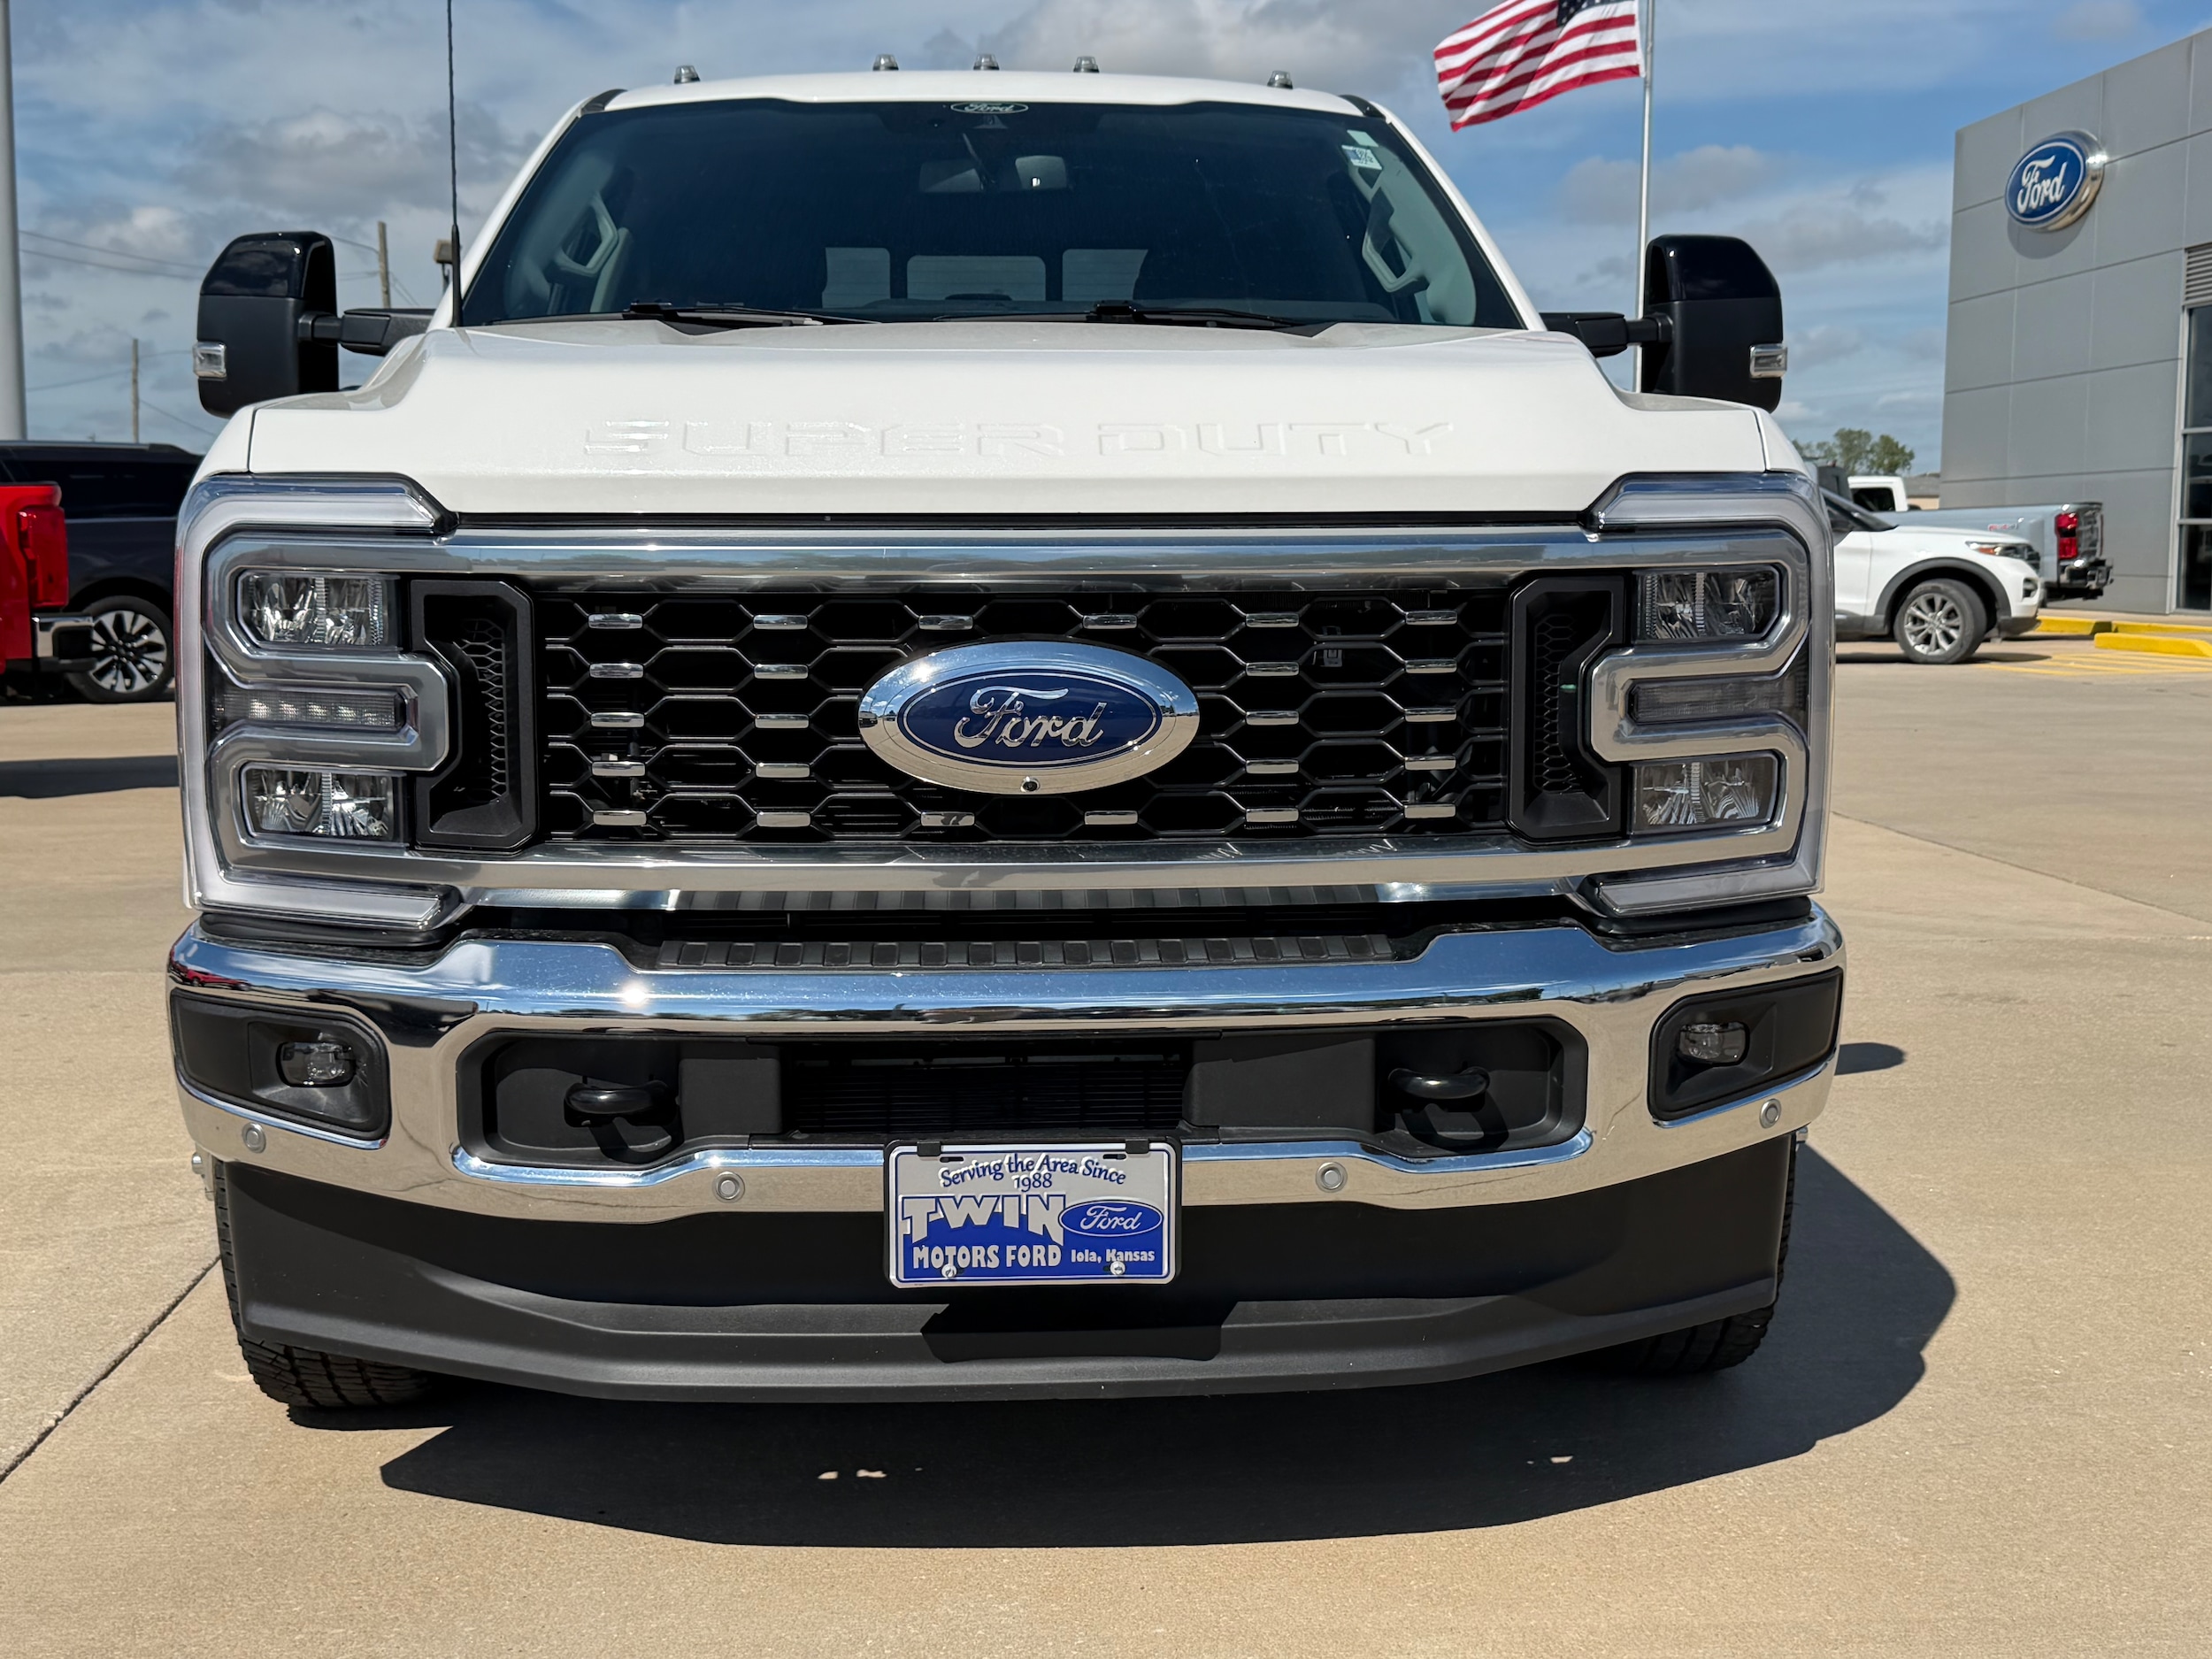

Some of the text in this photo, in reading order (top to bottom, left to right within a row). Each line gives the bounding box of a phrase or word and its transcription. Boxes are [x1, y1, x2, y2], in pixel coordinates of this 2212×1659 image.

[964, 103, 1015, 112] Ford
[2016, 154, 2069, 214] Ford
[583, 420, 1455, 456] SUPER DUTY
[953, 685, 1108, 749] Ford
[940, 1152, 1127, 1188] Serving the Area Since
[1015, 1172, 1054, 1193] 1988
[901, 1194, 1066, 1247] TWIN
[1079, 1205, 1141, 1232] Ford
[912, 1244, 1063, 1270] MOTORS FORD
[1071, 1248, 1156, 1263] Iola, Kansas
